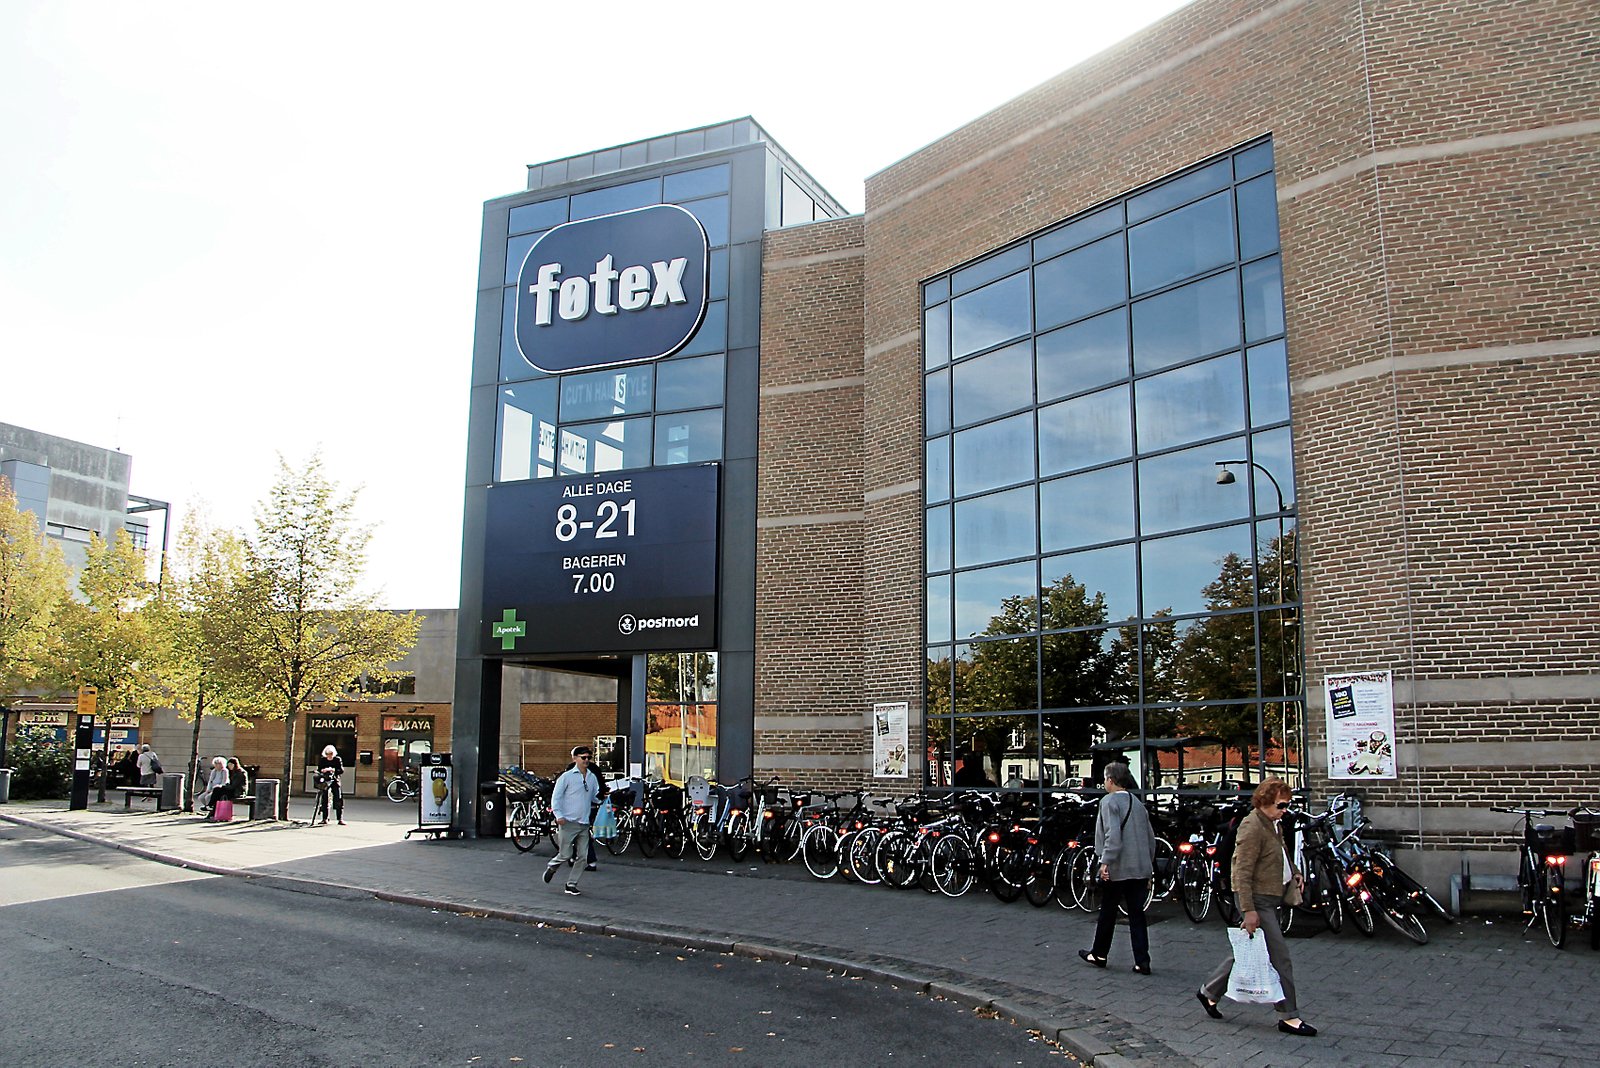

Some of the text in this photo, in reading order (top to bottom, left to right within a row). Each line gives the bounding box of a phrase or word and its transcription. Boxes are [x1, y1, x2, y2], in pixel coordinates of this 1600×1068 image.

[529, 254, 688, 326] føtex
[562, 480, 632, 498] ALLE DAGE
[555, 499, 636, 542] 8-21
[563, 554, 626, 570] BAGEREN
[572, 572, 615, 594] 7.00
[496, 626, 521, 635] Apotek
[638, 614, 699, 631] postnord
[311, 719, 355, 729] IZAKAYA
